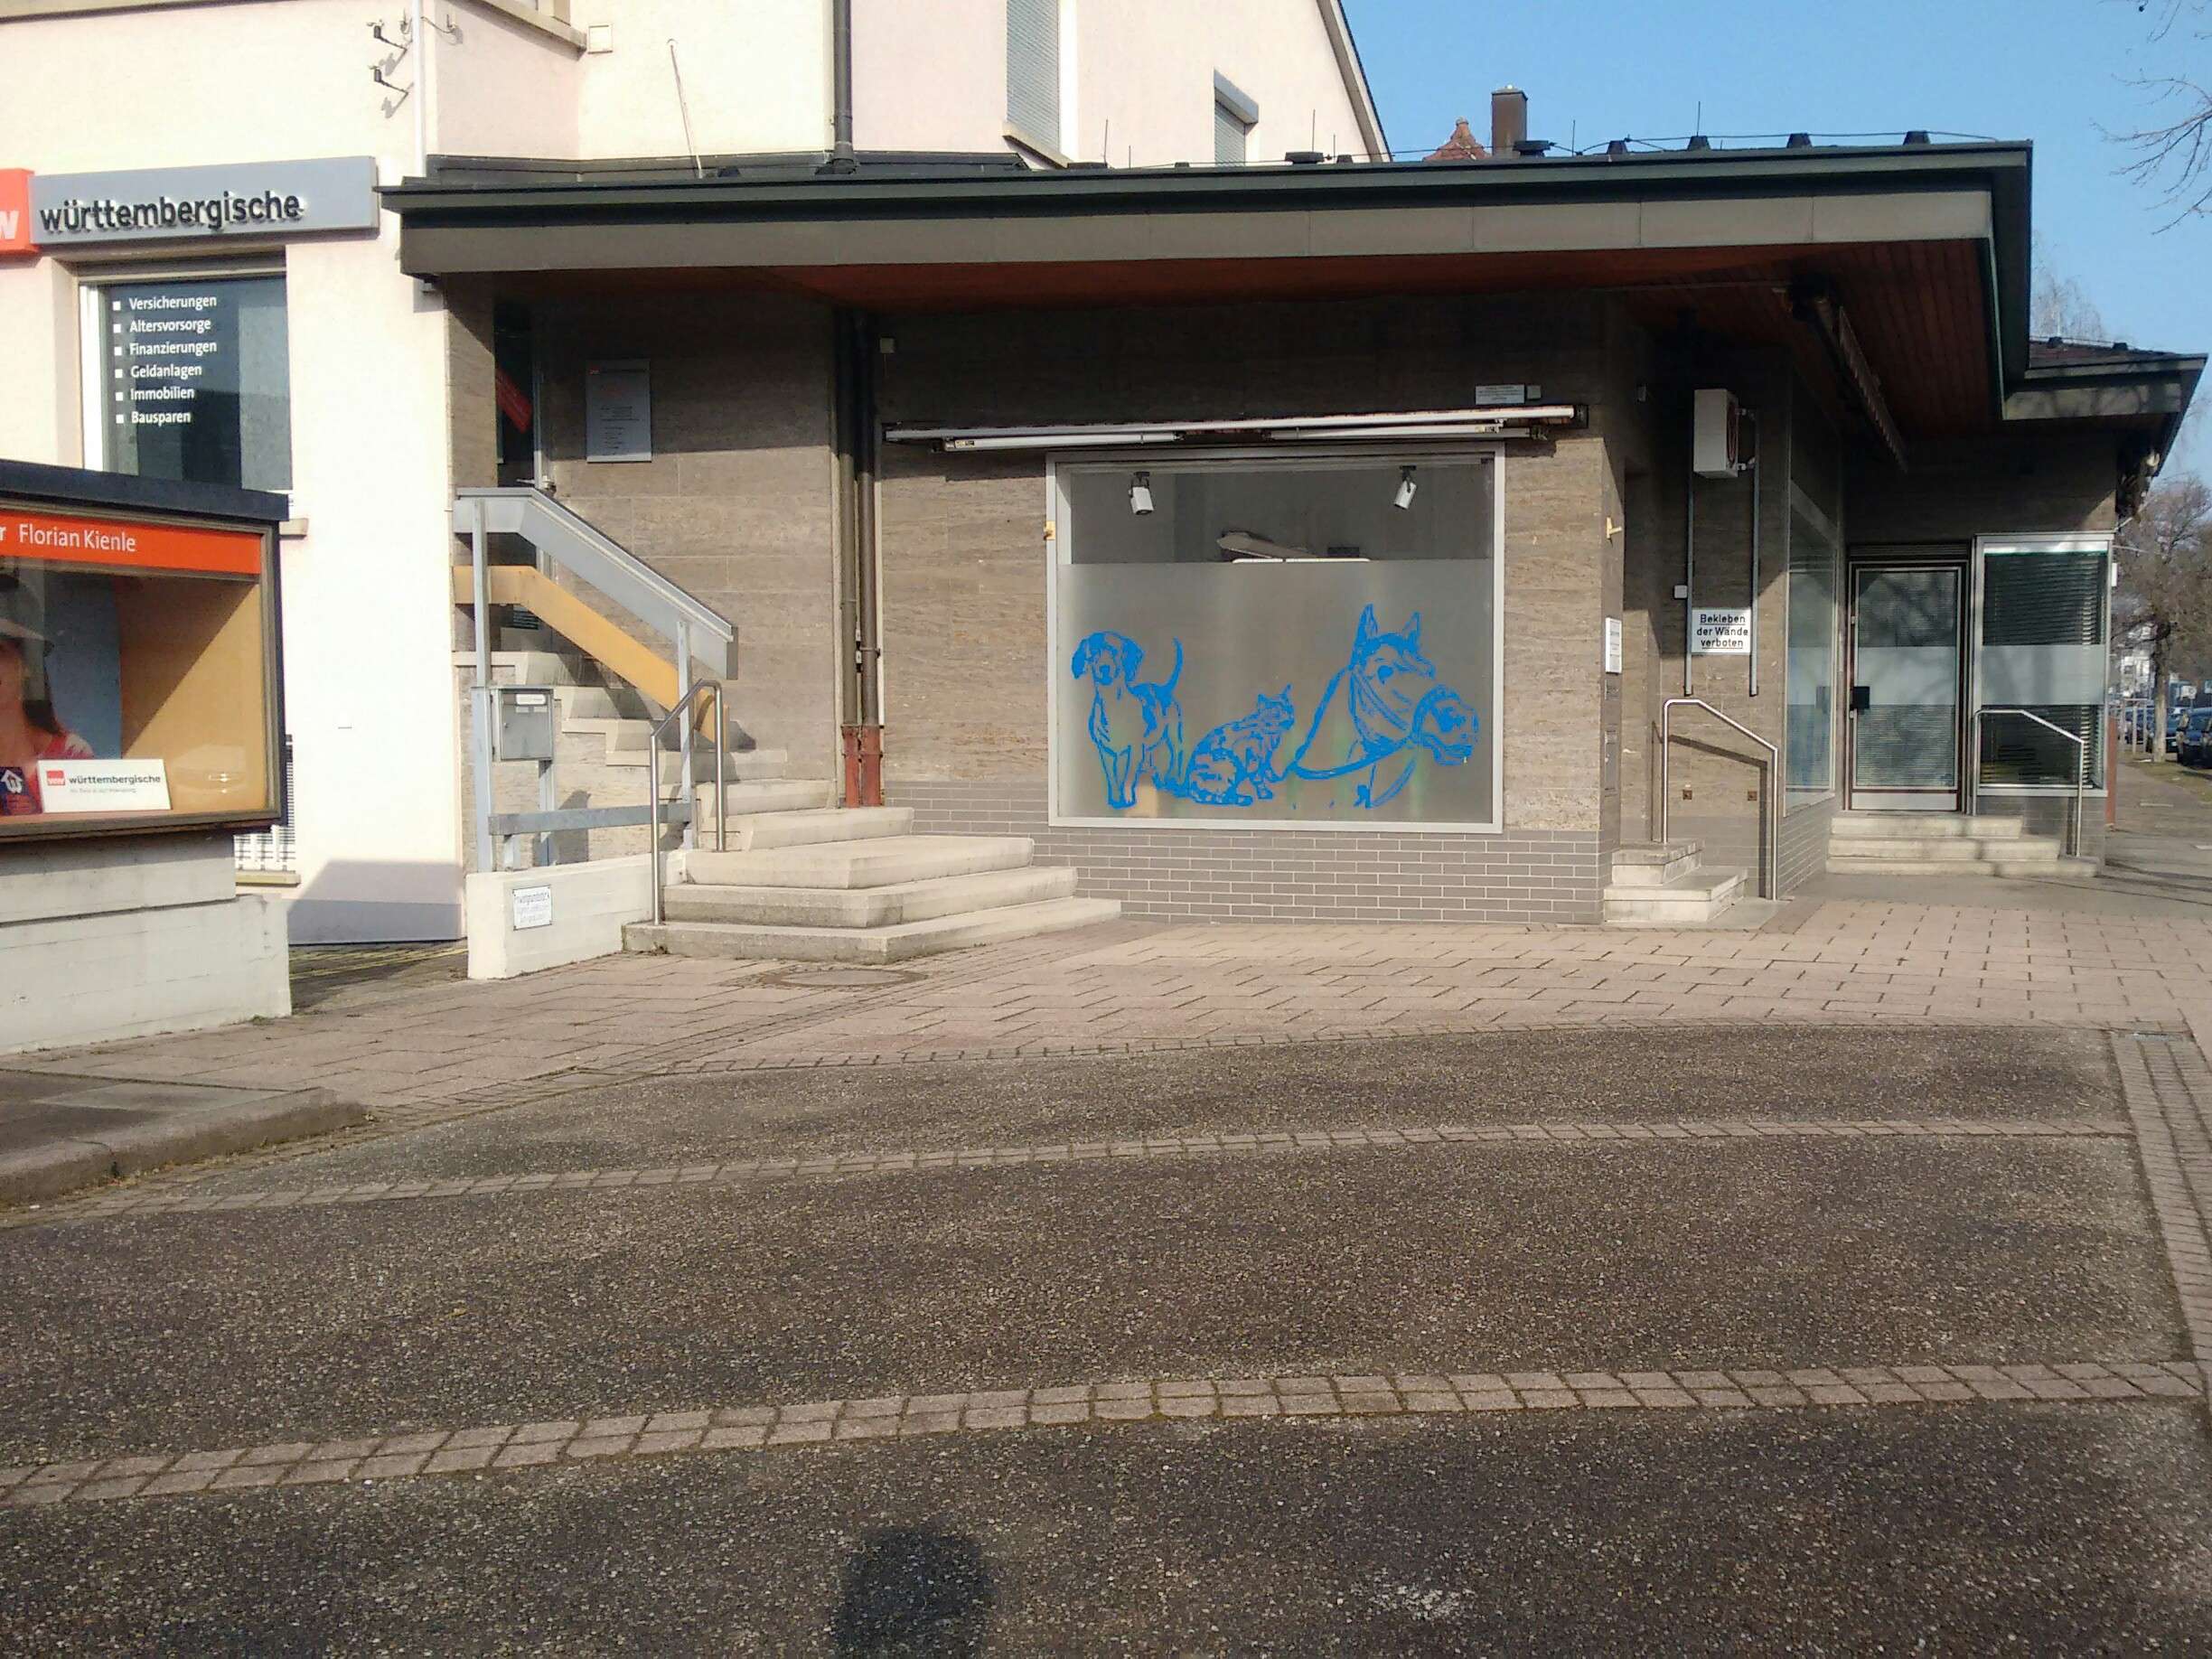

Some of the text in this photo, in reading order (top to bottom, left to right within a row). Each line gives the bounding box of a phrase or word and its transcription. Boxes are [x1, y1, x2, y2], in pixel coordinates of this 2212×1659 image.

[40, 190, 301, 230] württembergische
[128, 295, 217, 311] Versicherungen
[129, 318, 211, 334] Altersvorsorge
[129, 341, 217, 357] Finanzierungen
[130, 363, 202, 380] Geldanlagen
[130, 386, 195, 400] Immobilien
[131, 411, 191, 427] Bausparen
[19, 523, 80, 548] Florian
[84, 530, 136, 552] Kienle
[1700, 614, 1746, 623] Bekleben
[1696, 626, 1748, 636] der Wände
[1701, 638, 1744, 647] verboten
[69, 774, 161, 784] württembergische
